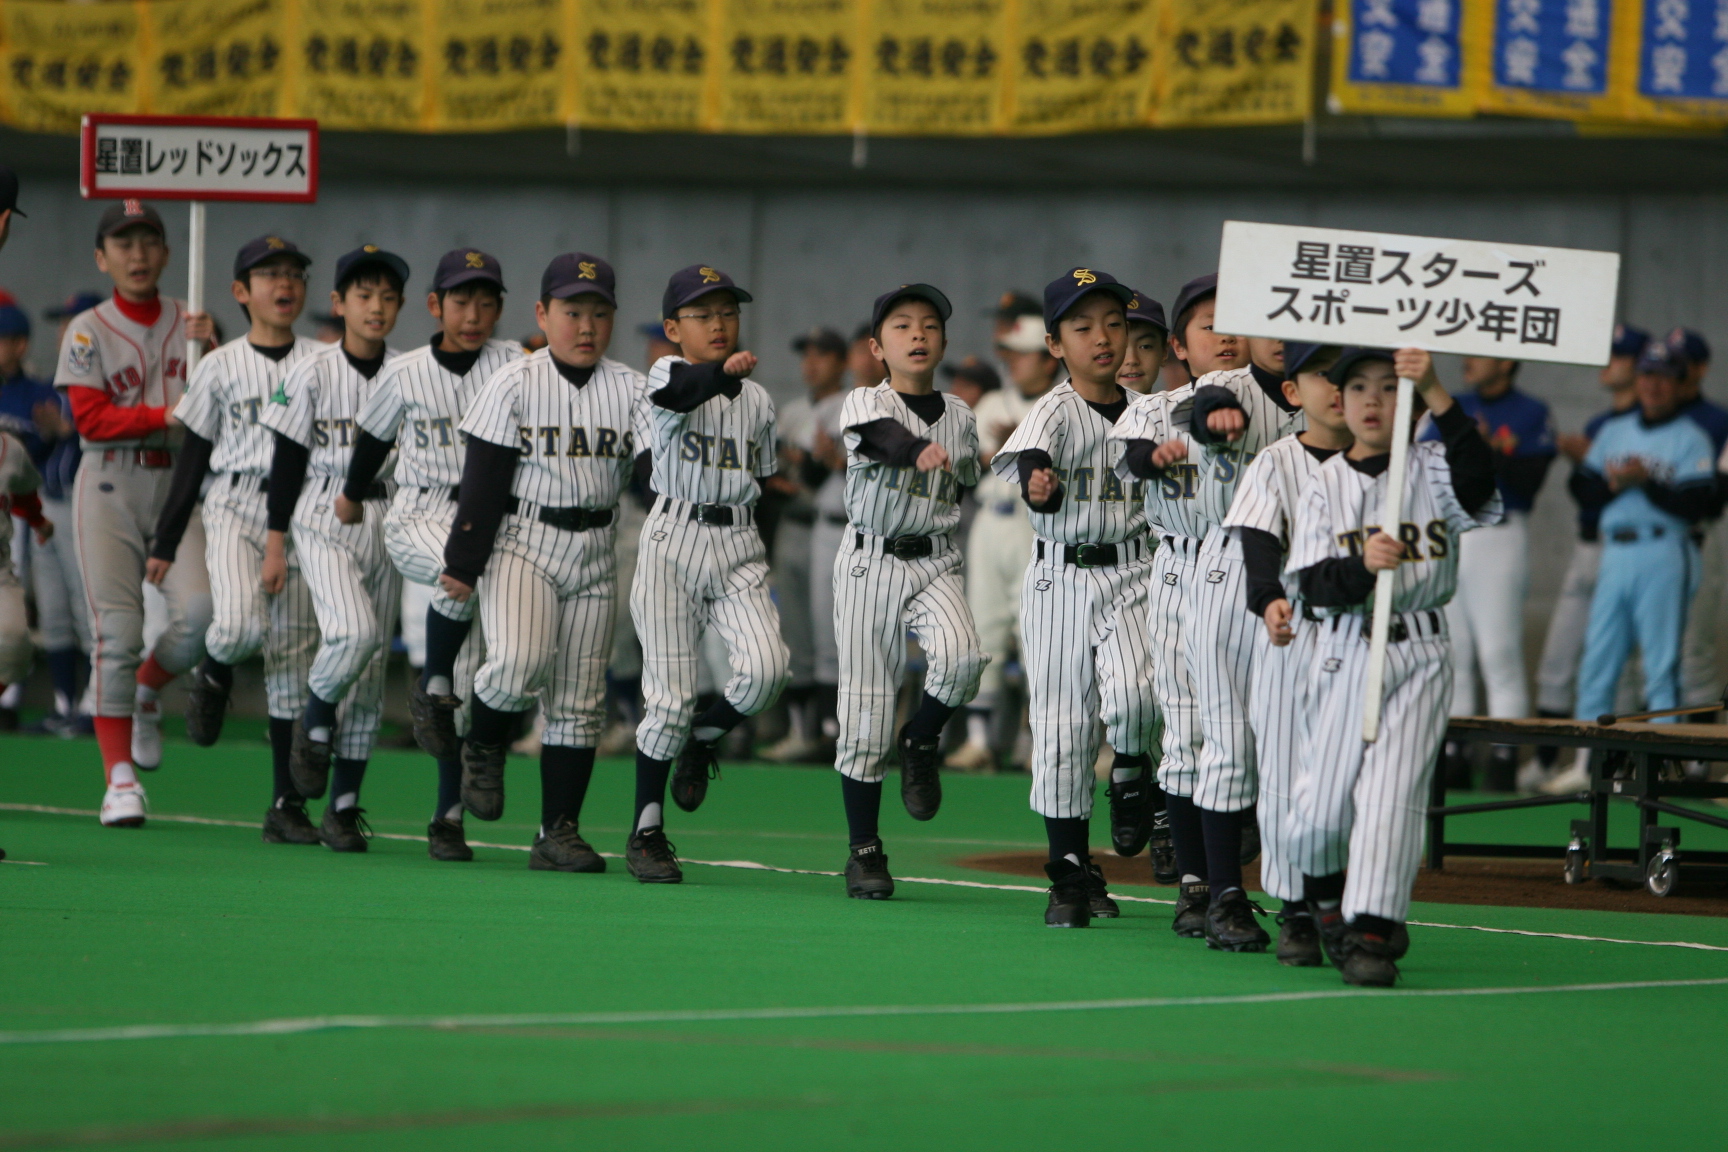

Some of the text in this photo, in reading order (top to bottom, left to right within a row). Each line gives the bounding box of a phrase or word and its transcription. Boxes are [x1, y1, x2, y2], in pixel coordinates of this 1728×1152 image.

[96, 137, 306, 178] 星置レッドソックス
[1290, 240, 1546, 297] 星置スターズ
[1266, 285, 1561, 347] スポーツ少年団
